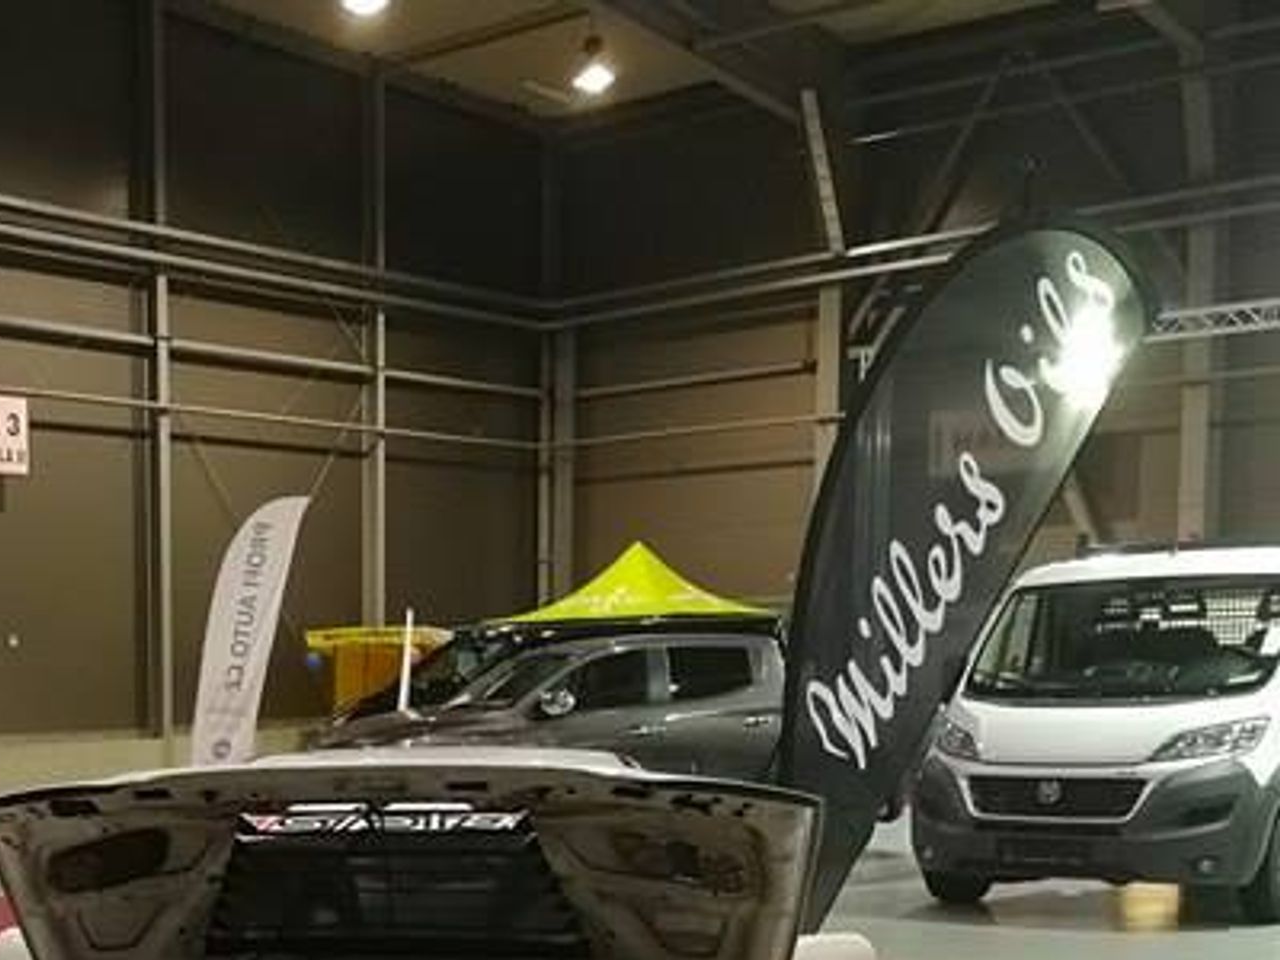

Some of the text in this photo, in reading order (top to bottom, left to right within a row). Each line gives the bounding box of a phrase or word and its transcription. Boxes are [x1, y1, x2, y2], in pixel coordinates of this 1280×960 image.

[6, 411, 22, 437] 3
[806, 249, 1115, 770] Millers Oils
